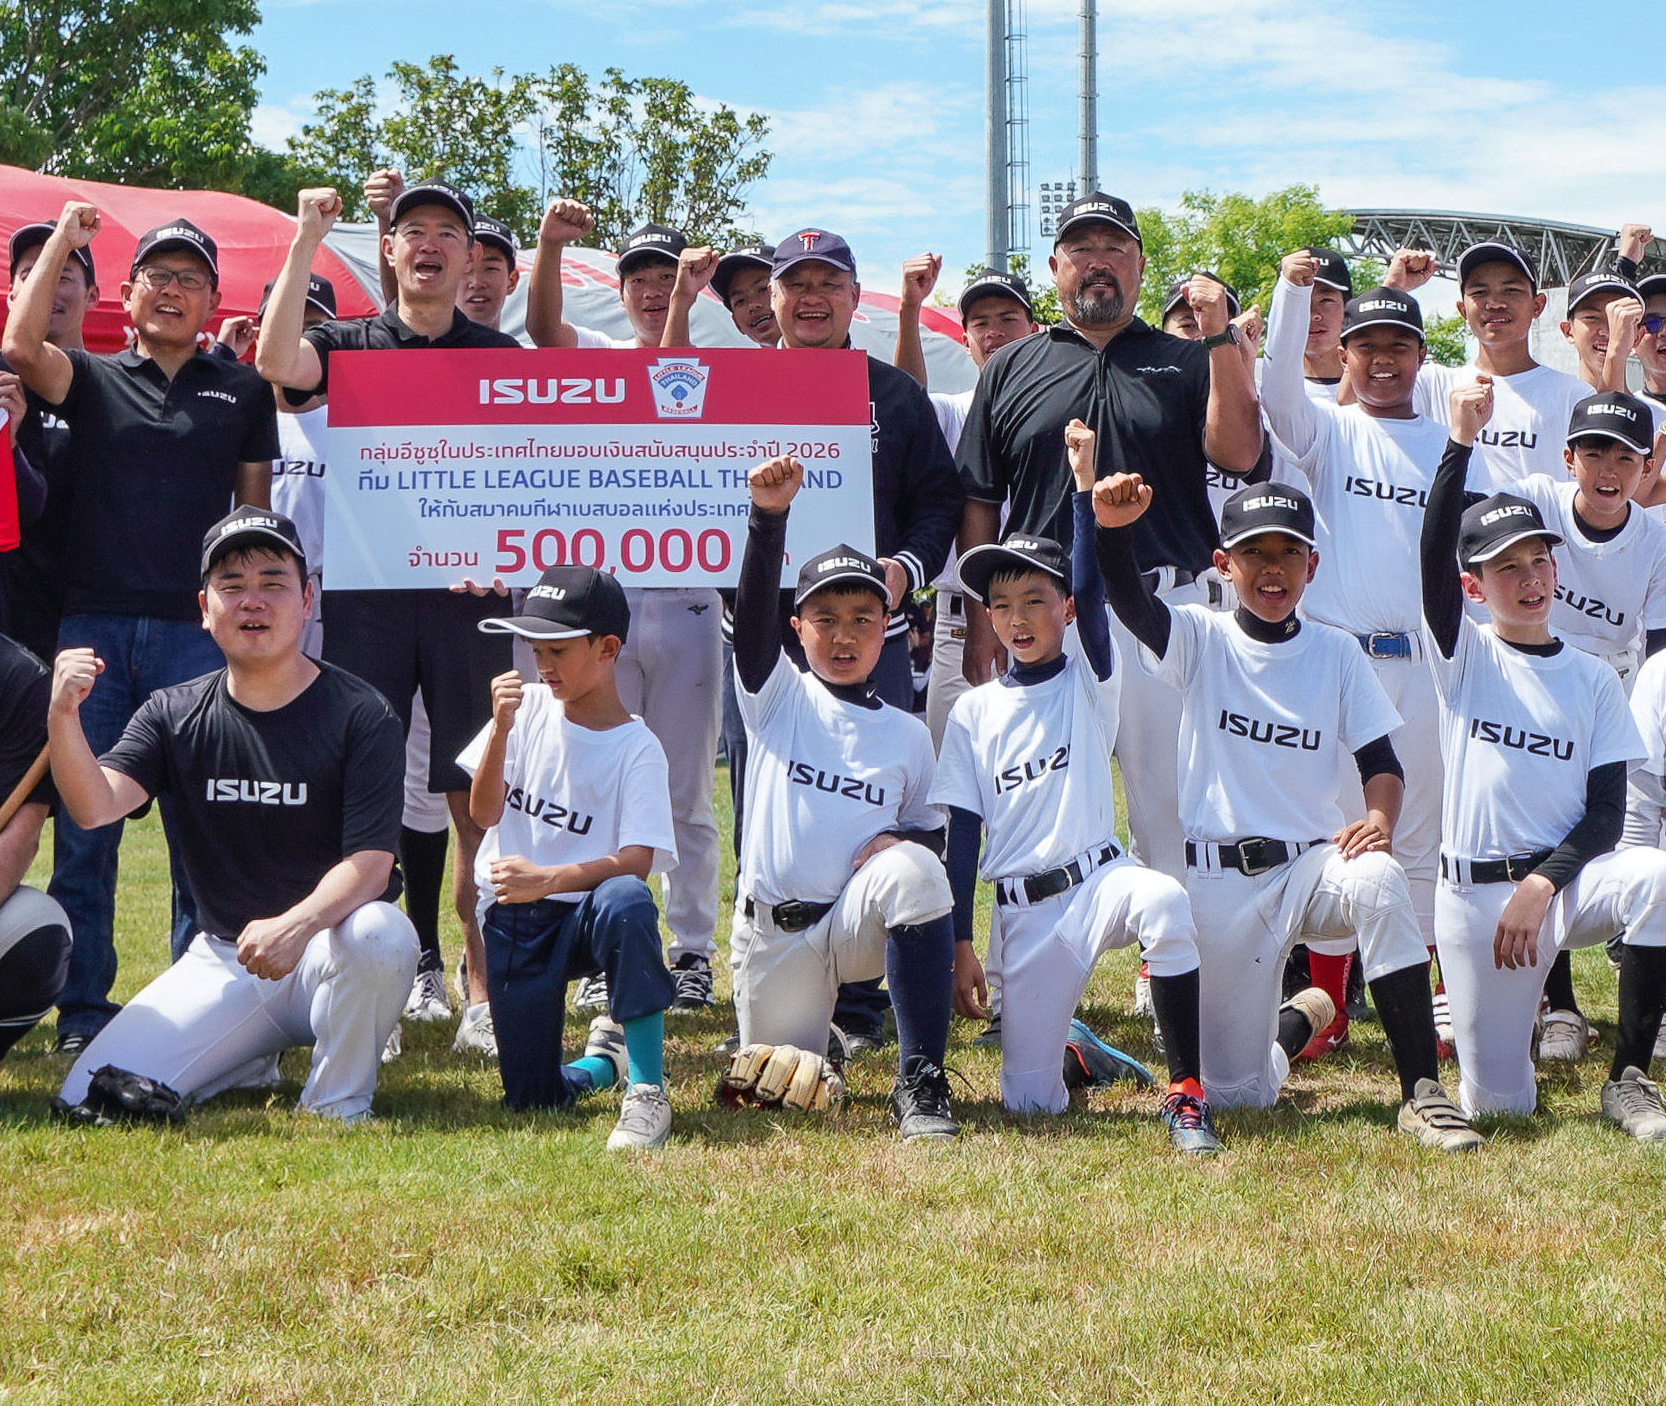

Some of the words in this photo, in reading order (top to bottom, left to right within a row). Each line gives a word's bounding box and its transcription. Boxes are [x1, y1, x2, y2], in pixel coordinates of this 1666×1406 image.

[1074, 202, 1118, 216] ISUZU
[1358, 300, 1408, 313] ISUZU
[479, 377, 625, 405] ISUZU
[1587, 405, 1638, 422] ISUZU
[788, 442, 840, 459] 2026
[1475, 430, 1538, 450] UZU
[272, 460, 326, 478] UZU
[358, 470, 390, 490] ทีม
[397, 470, 476, 490] LITTLE
[484, 469, 581, 489] LEAGUE
[589, 469, 712, 489] BASEBALL
[718, 469, 843, 489] THND
[1242, 496, 1299, 512] ISUZU
[1480, 504, 1533, 526] ISUZU
[220, 517, 278, 537] ISUZU
[408, 546, 479, 567] จำนวน
[495, 528, 731, 576] 500,000
[818, 556, 871, 574] ISUZU
[1553, 585, 1626, 626] SUZU
[1219, 709, 1322, 753] ISUZU
[1470, 718, 1575, 762] ISUZU
[995, 744, 1071, 798] ISUZ
[206, 778, 308, 806] ISUZU
[787, 760, 886, 808] ISUZU
